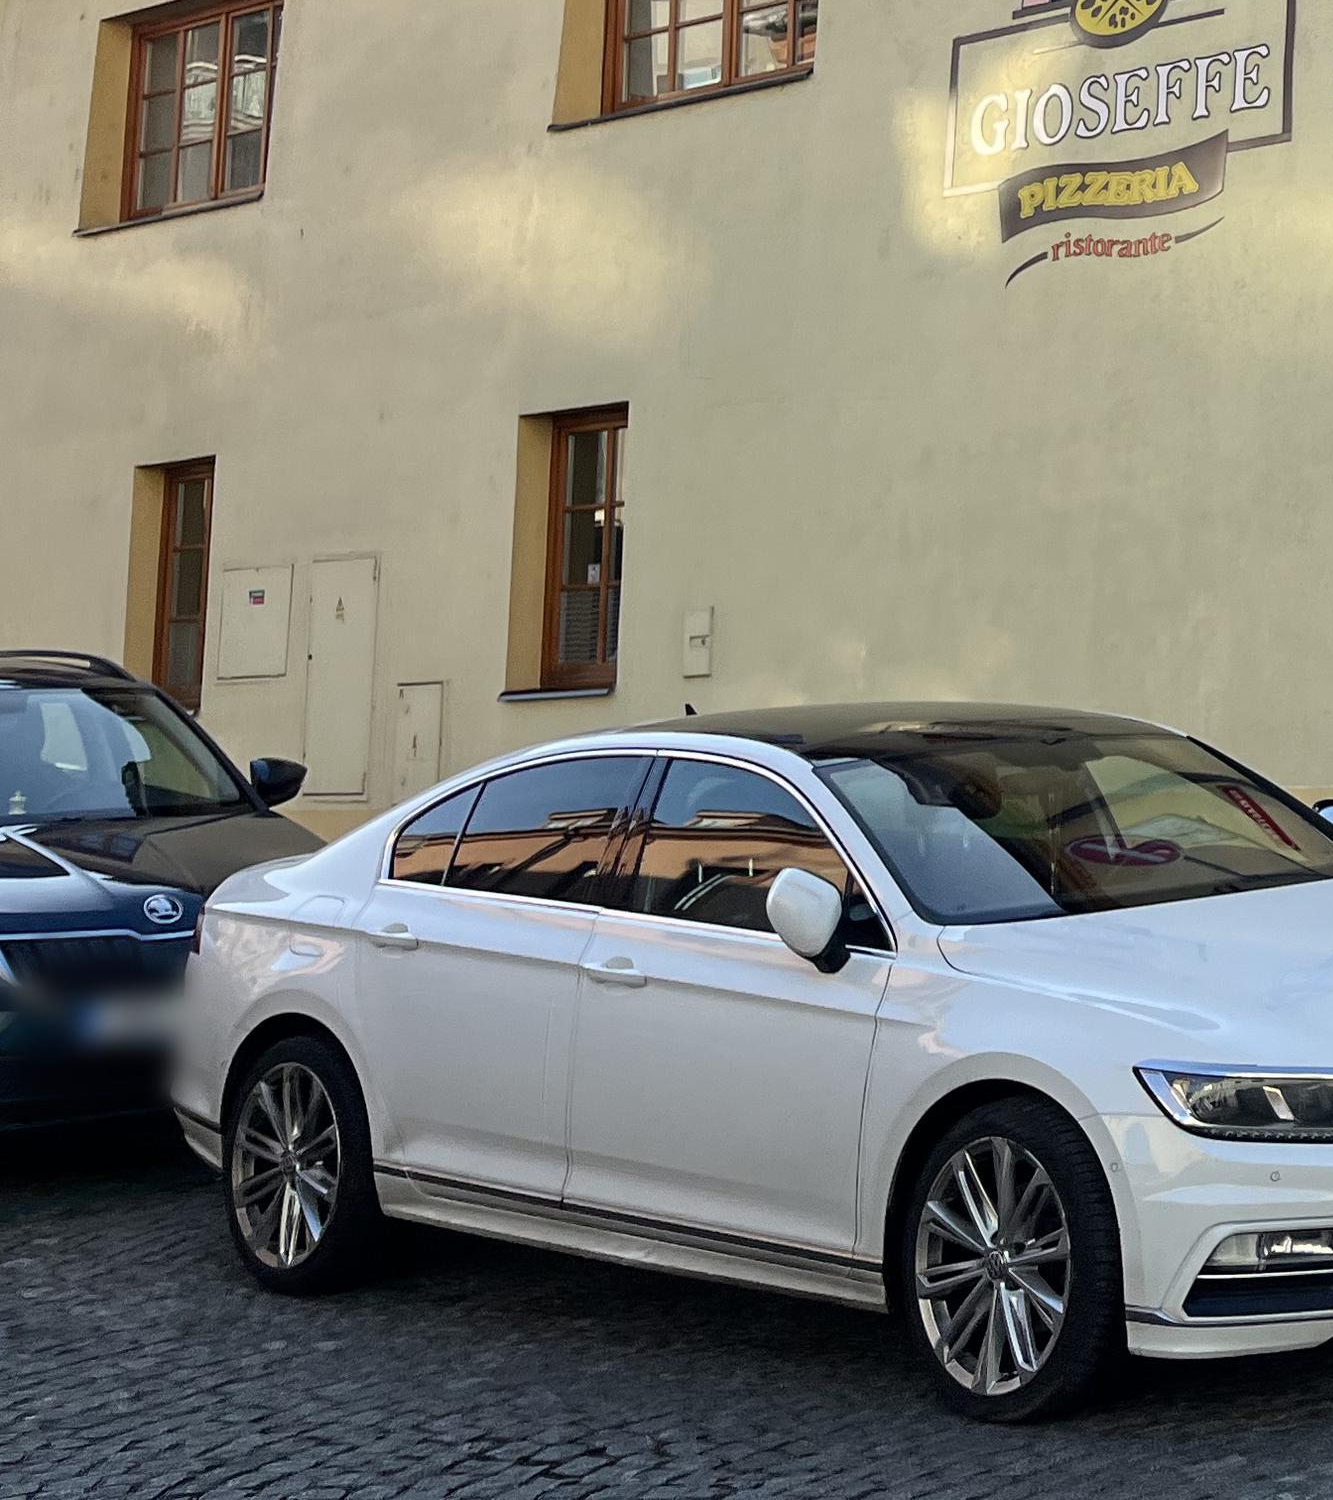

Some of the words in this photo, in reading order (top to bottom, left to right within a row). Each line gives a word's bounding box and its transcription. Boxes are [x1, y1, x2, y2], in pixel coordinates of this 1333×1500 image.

[970, 44, 1270, 156] GIOSEFFE
[1018, 161, 1199, 219] PIZZERIA
[1051, 231, 1174, 261] ristorante
